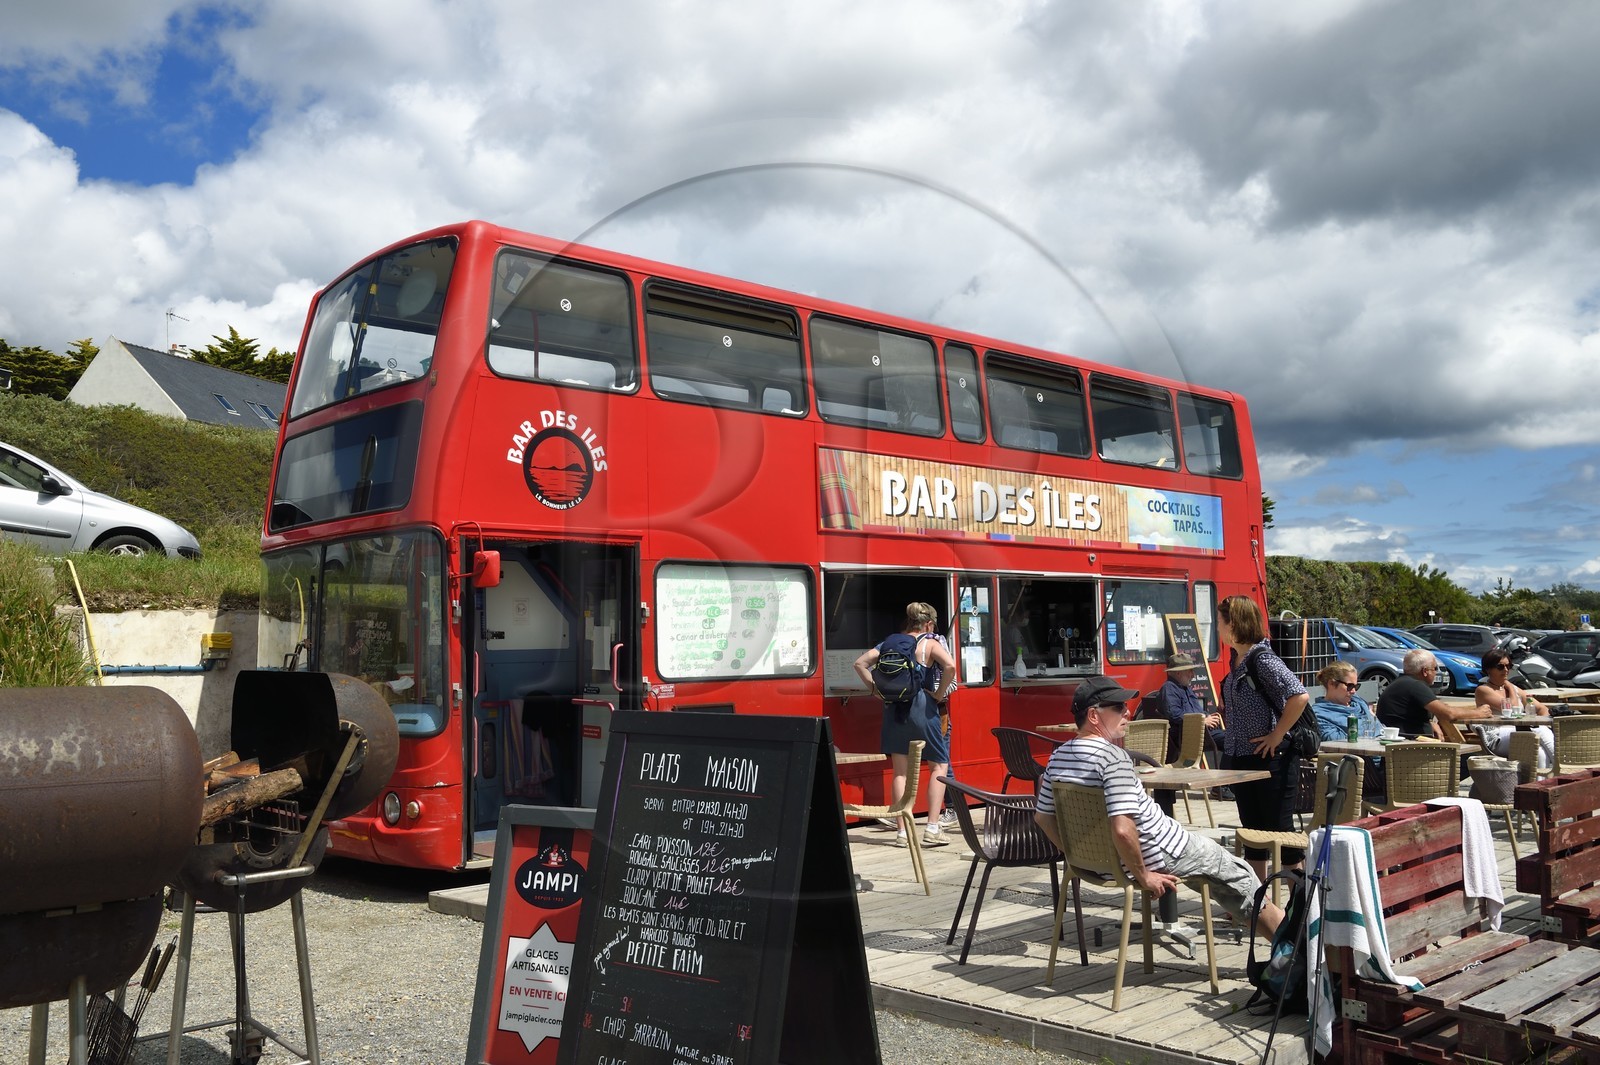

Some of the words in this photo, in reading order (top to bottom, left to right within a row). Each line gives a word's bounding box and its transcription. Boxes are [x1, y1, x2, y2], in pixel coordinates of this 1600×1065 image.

[507, 420, 538, 464] BAR
[540, 410, 578, 431] DES
[581, 427, 608, 472] ILES
[882, 470, 958, 520] BAR
[973, 480, 1037, 527] DES
[1040, 480, 1102, 532] ÎLES
[1147, 499, 1201, 518] COCKTAILS
[1173, 519, 1212, 535] TAPAS...
[639, 753, 681, 784] PLATS
[693, 841, 725, 857] 12€
[522, 870, 579, 893] JAMPI
[652, 872, 671, 891] VERT
[672, 873, 682, 893] DE
[686, 875, 715, 896] POULET
[714, 878, 745, 896] 12€
[664, 896, 690, 910] 14€
[604, 905, 616, 919] LES
[619, 907, 640, 924] PLATS
[641, 911, 660, 927] SONT
[660, 912, 685, 931] SERVIS
[686, 916, 703, 935] AVEC
[705, 918, 716, 937] DU
[718, 919, 731, 939] RIZ
[733, 922, 746, 941] ET
[640, 927, 669, 945] HARICOTS
[672, 933, 696, 948] ROUGES
[525, 948, 559, 961] GLACES
[626, 940, 667, 969] PETITE
[672, 948, 703, 975] FAIM
[512, 960, 570, 976] ARTISANALES
[509, 985, 522, 996] EN
[524, 987, 553, 1000] VENTE
[554, 991, 567, 1002] ICI
[505, 1010, 562, 1025] jampiglacier.com
[675, 1044, 700, 1061] NATURE
